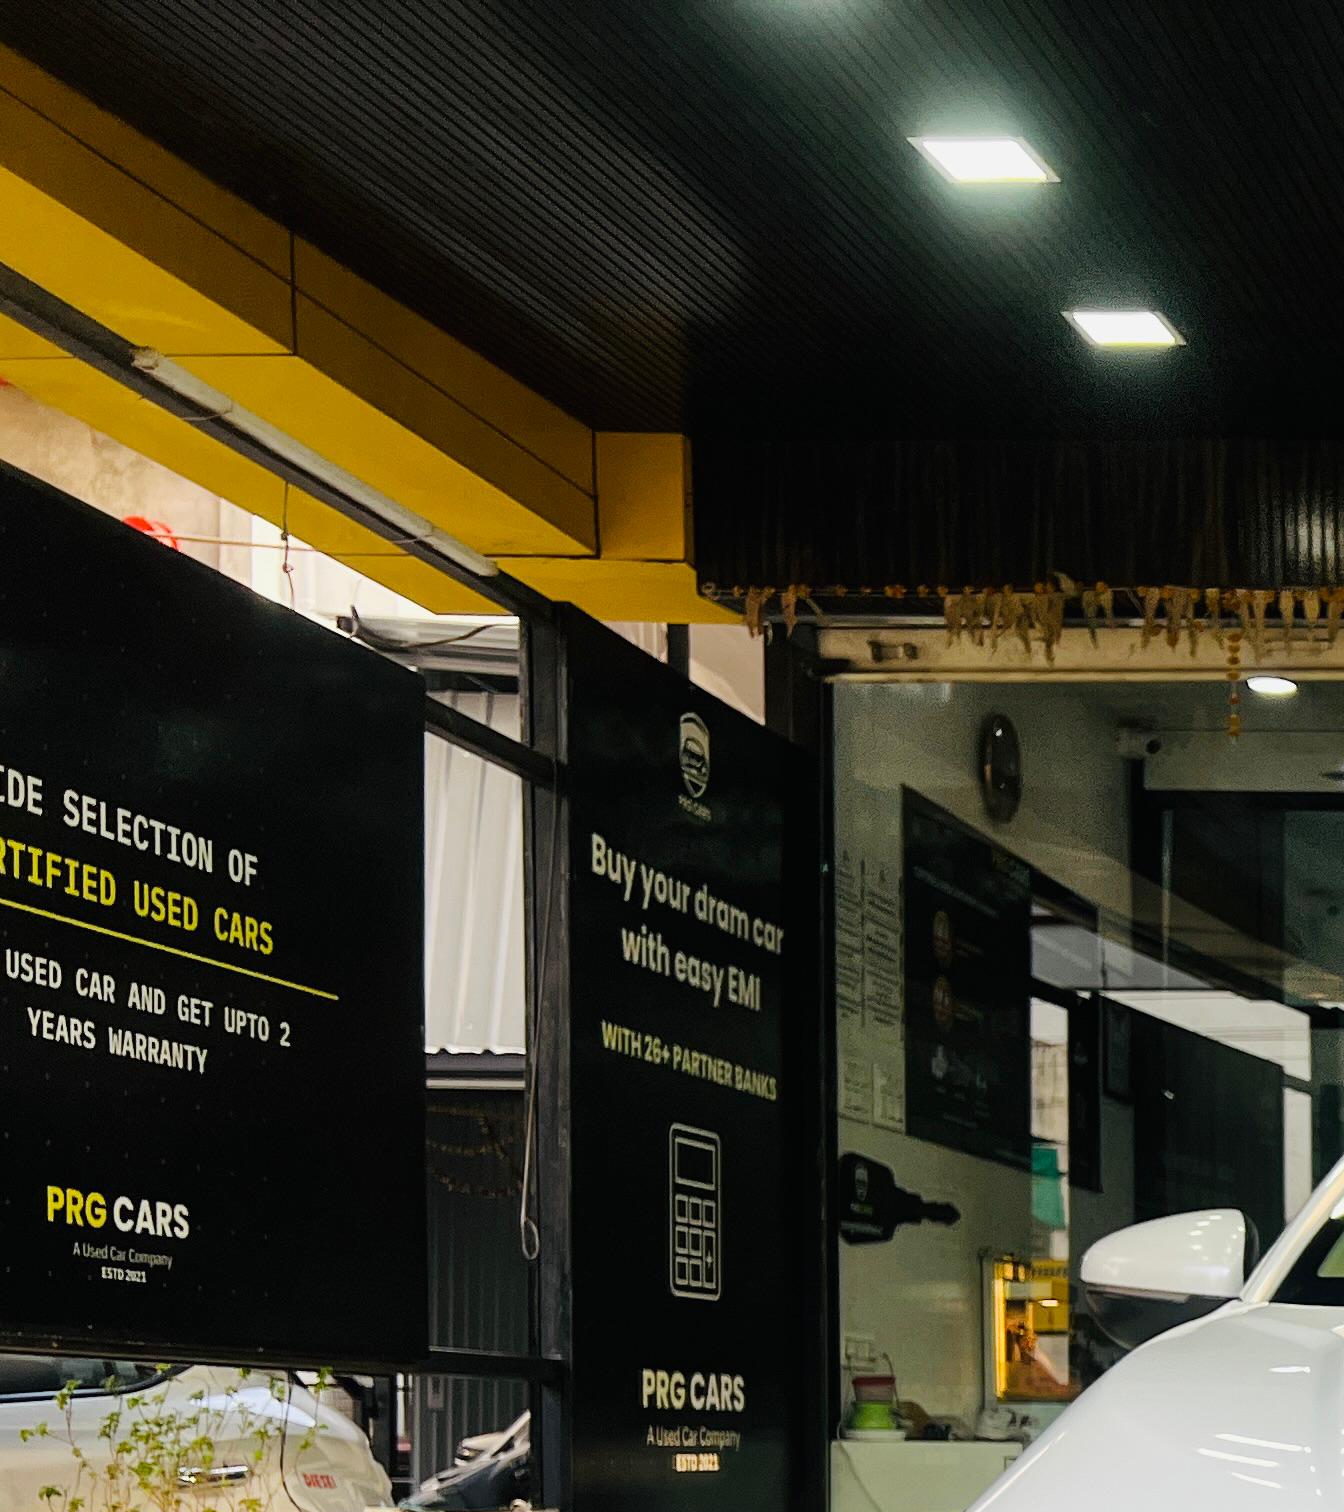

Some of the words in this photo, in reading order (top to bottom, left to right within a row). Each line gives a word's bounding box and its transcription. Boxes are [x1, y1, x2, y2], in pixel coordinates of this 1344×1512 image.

[63, 788, 213, 873] SELECTION
[228, 848, 259, 886] OF
[134, 880, 198, 931] USED
[214, 907, 273, 955] CARS
[591, 832, 636, 901] Buy
[641, 862, 690, 910] your
[694, 883, 749, 942] dram
[753, 917, 785, 955] car
[6, 948, 62, 989] USED
[75, 968, 115, 1003] CAR
[128, 982, 165, 1015] AND
[177, 994, 214, 1027] GET
[224, 1006, 269, 1042] UPTO
[279, 1022, 291, 1047] 2
[622, 924, 670, 976] with
[674, 951, 724, 1007] easy
[728, 966, 761, 1012] EMI
[27, 1007, 96, 1049] YEARS
[108, 1027, 207, 1075] WARRANTY
[601, 1020, 642, 1058] WITH
[673, 1046, 732, 1086] PARTNER
[735, 1064, 777, 1100] BANKS
[47, 1185, 107, 1228] PRG
[113, 1196, 190, 1239] CARS
[73, 1242, 81, 1256] A
[83, 1243, 108, 1260] Used
[110, 1246, 126, 1262] Car
[128, 1248, 173, 1271] Company
[642, 1368, 686, 1410] PRG
[690, 1371, 745, 1412] CARS
[646, 1424, 655, 1446] A
[656, 1425, 680, 1447] Used
[682, 1426, 698, 1447] Car
[700, 1425, 741, 1452] Company
